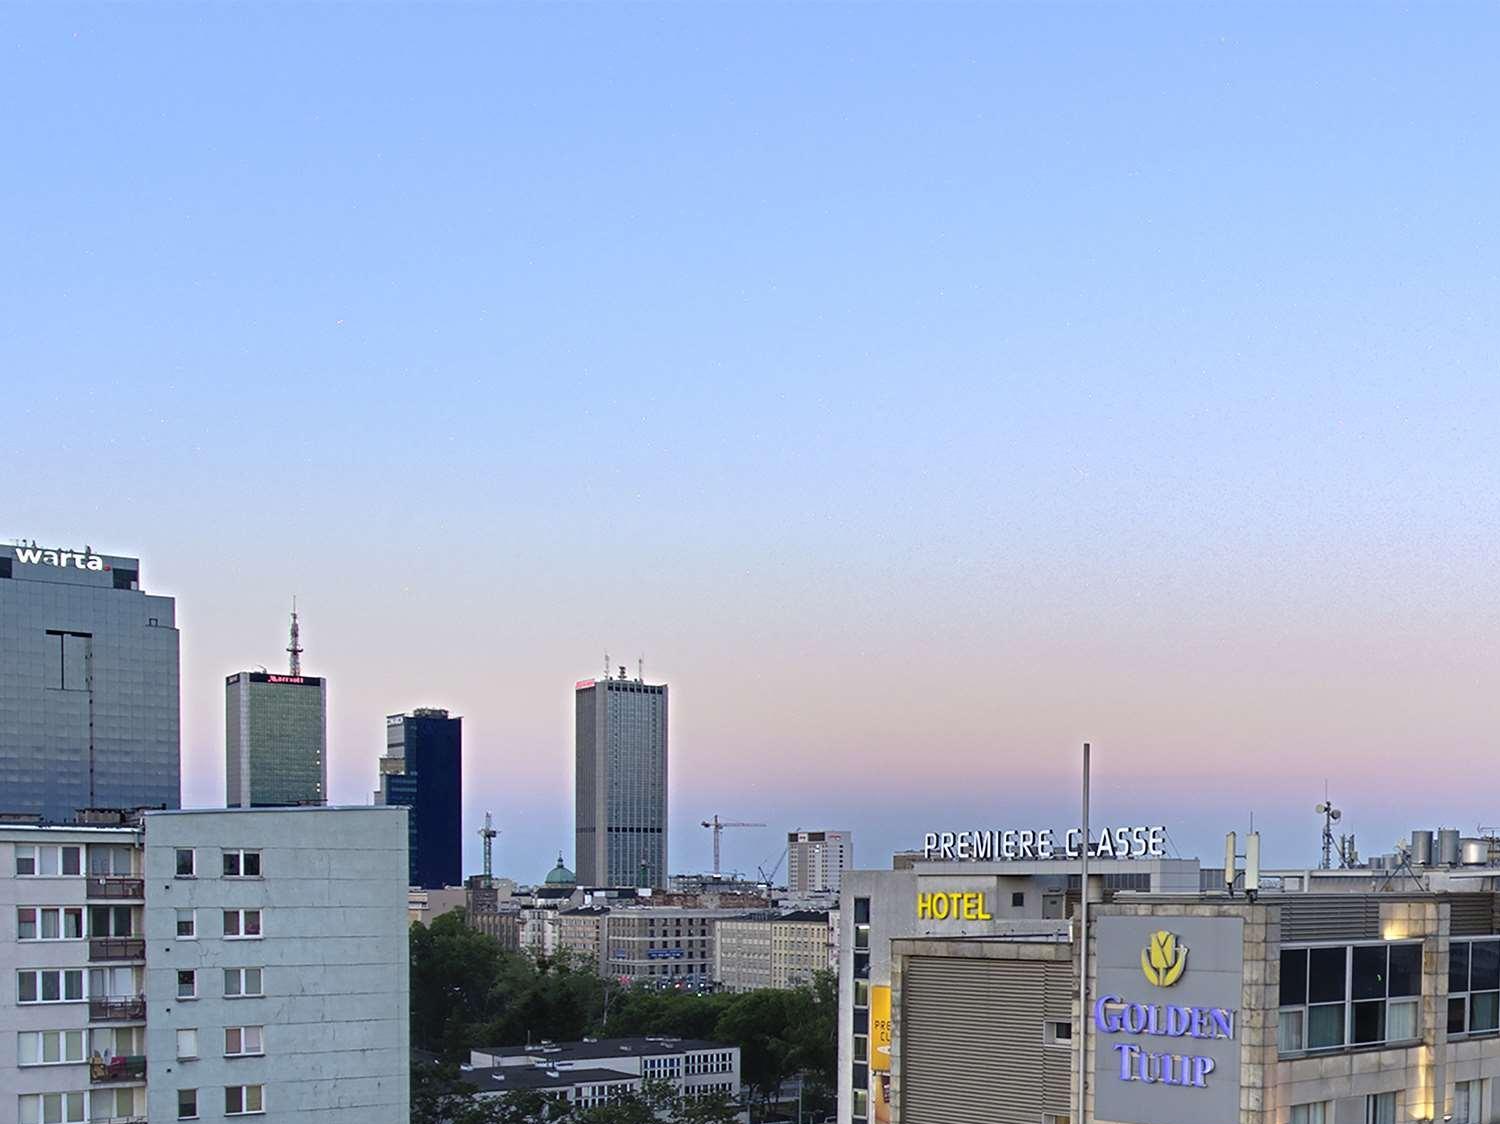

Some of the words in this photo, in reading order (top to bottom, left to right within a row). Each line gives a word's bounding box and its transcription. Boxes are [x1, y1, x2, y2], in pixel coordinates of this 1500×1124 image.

[924, 829, 1053, 858] PREMIERE
[917, 891, 992, 920] HOTEL
[1094, 994, 1237, 1040] GOLDEN
[1112, 1043, 1216, 1088] TULIP
